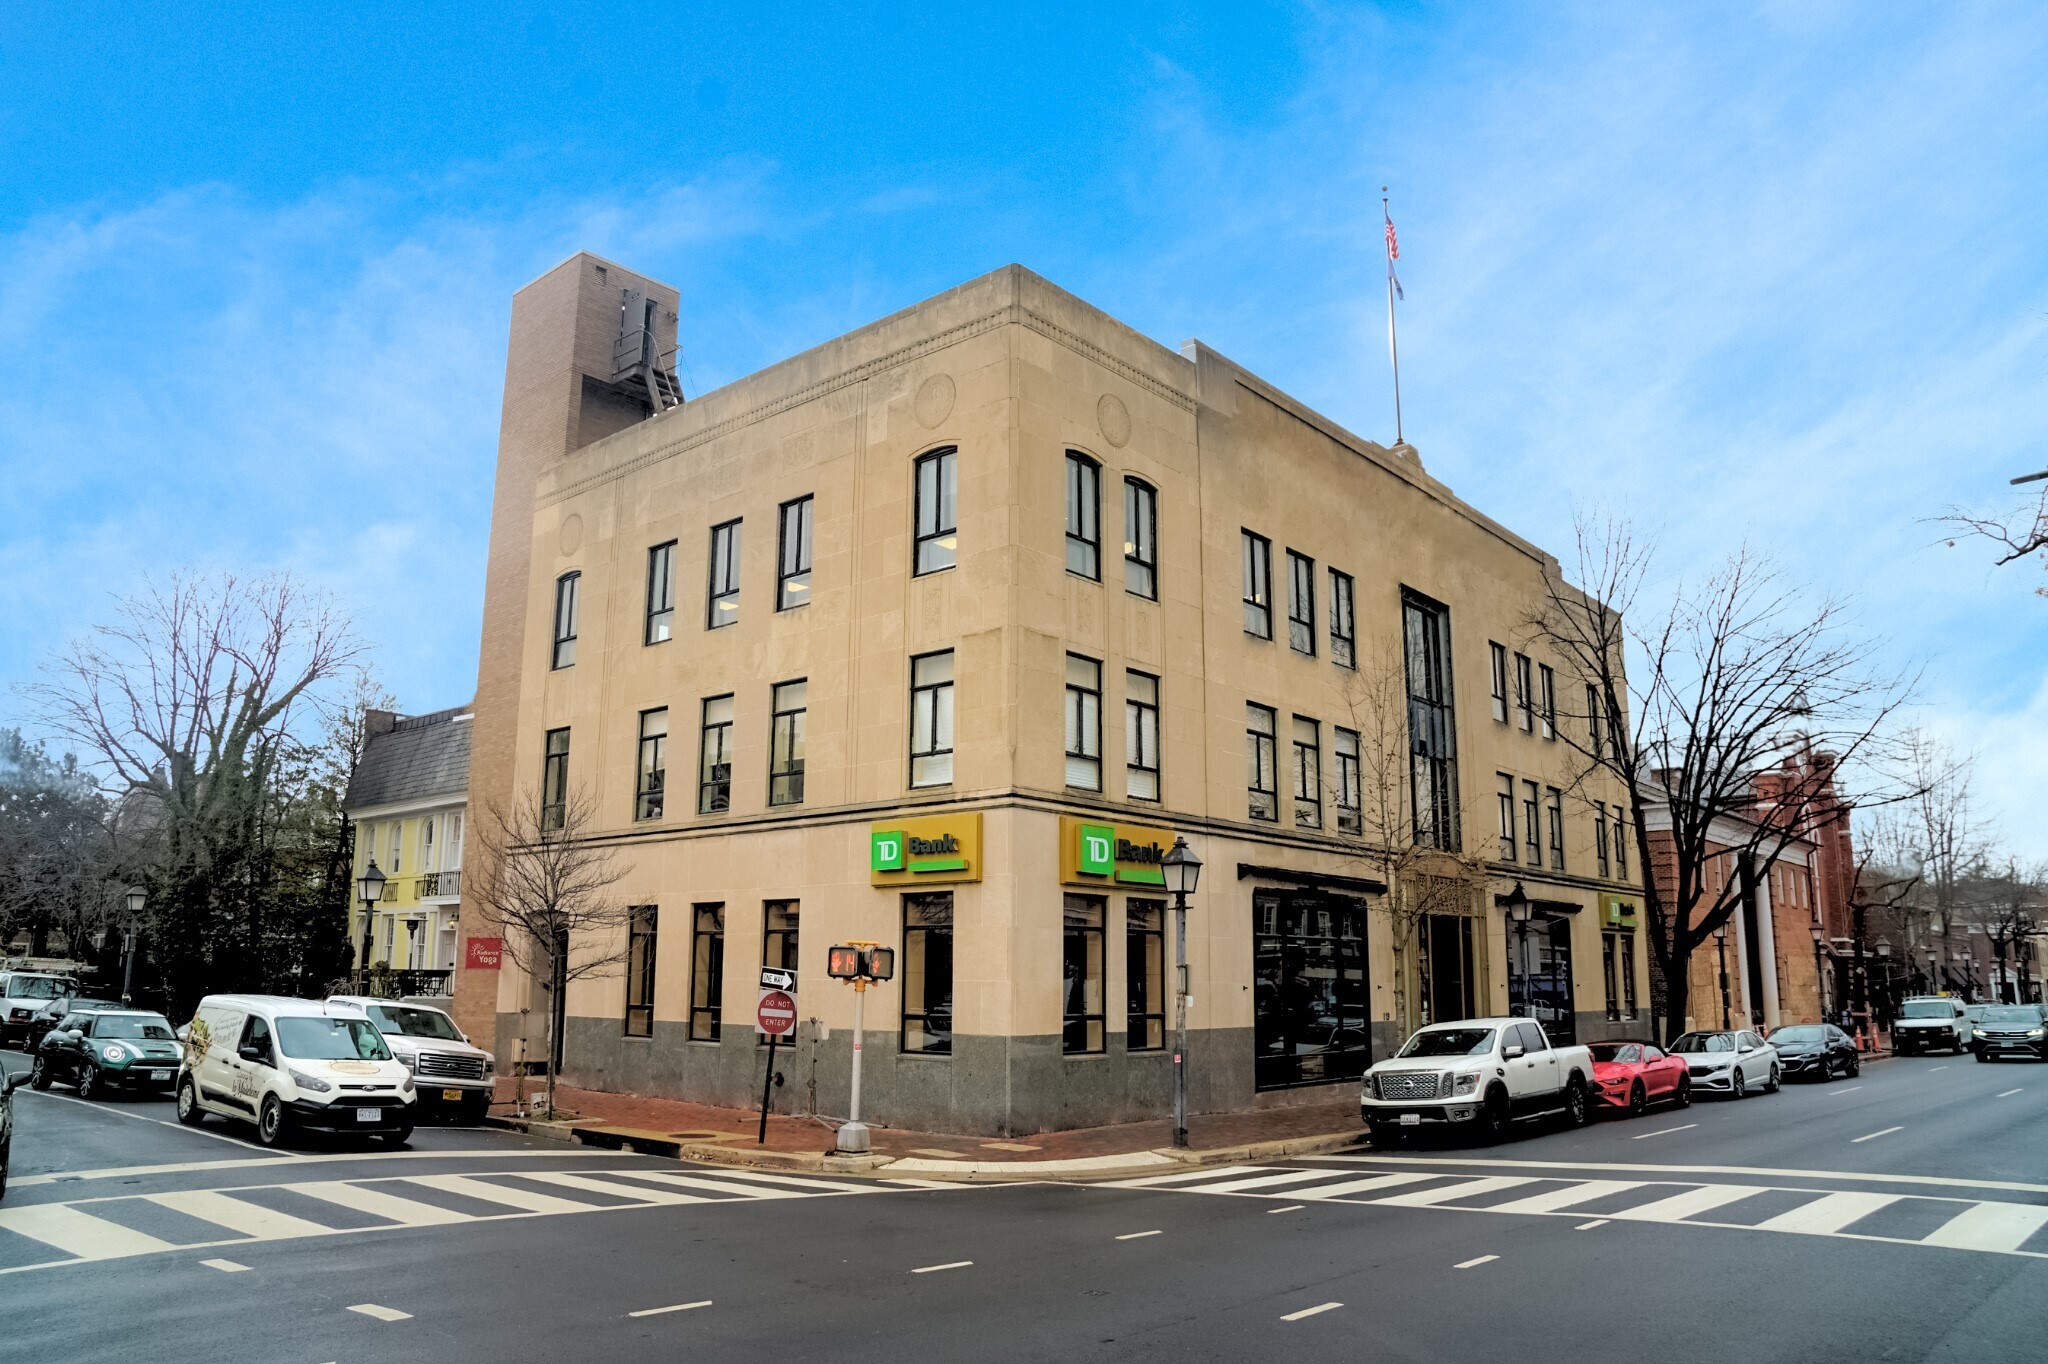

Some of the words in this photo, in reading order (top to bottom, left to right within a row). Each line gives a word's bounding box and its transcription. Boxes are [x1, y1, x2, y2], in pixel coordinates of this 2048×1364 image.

[876, 840, 898, 861] TD
[908, 833, 959, 854] Bank
[1086, 836, 1109, 862] TD
[1115, 838, 1165, 863] Bank
[479, 955, 497, 965] Yoga
[846, 953, 855, 972] 14
[763, 973, 773, 983] ONE
[773, 975, 784, 984] WAY
[765, 1018, 786, 1027] ENTER
